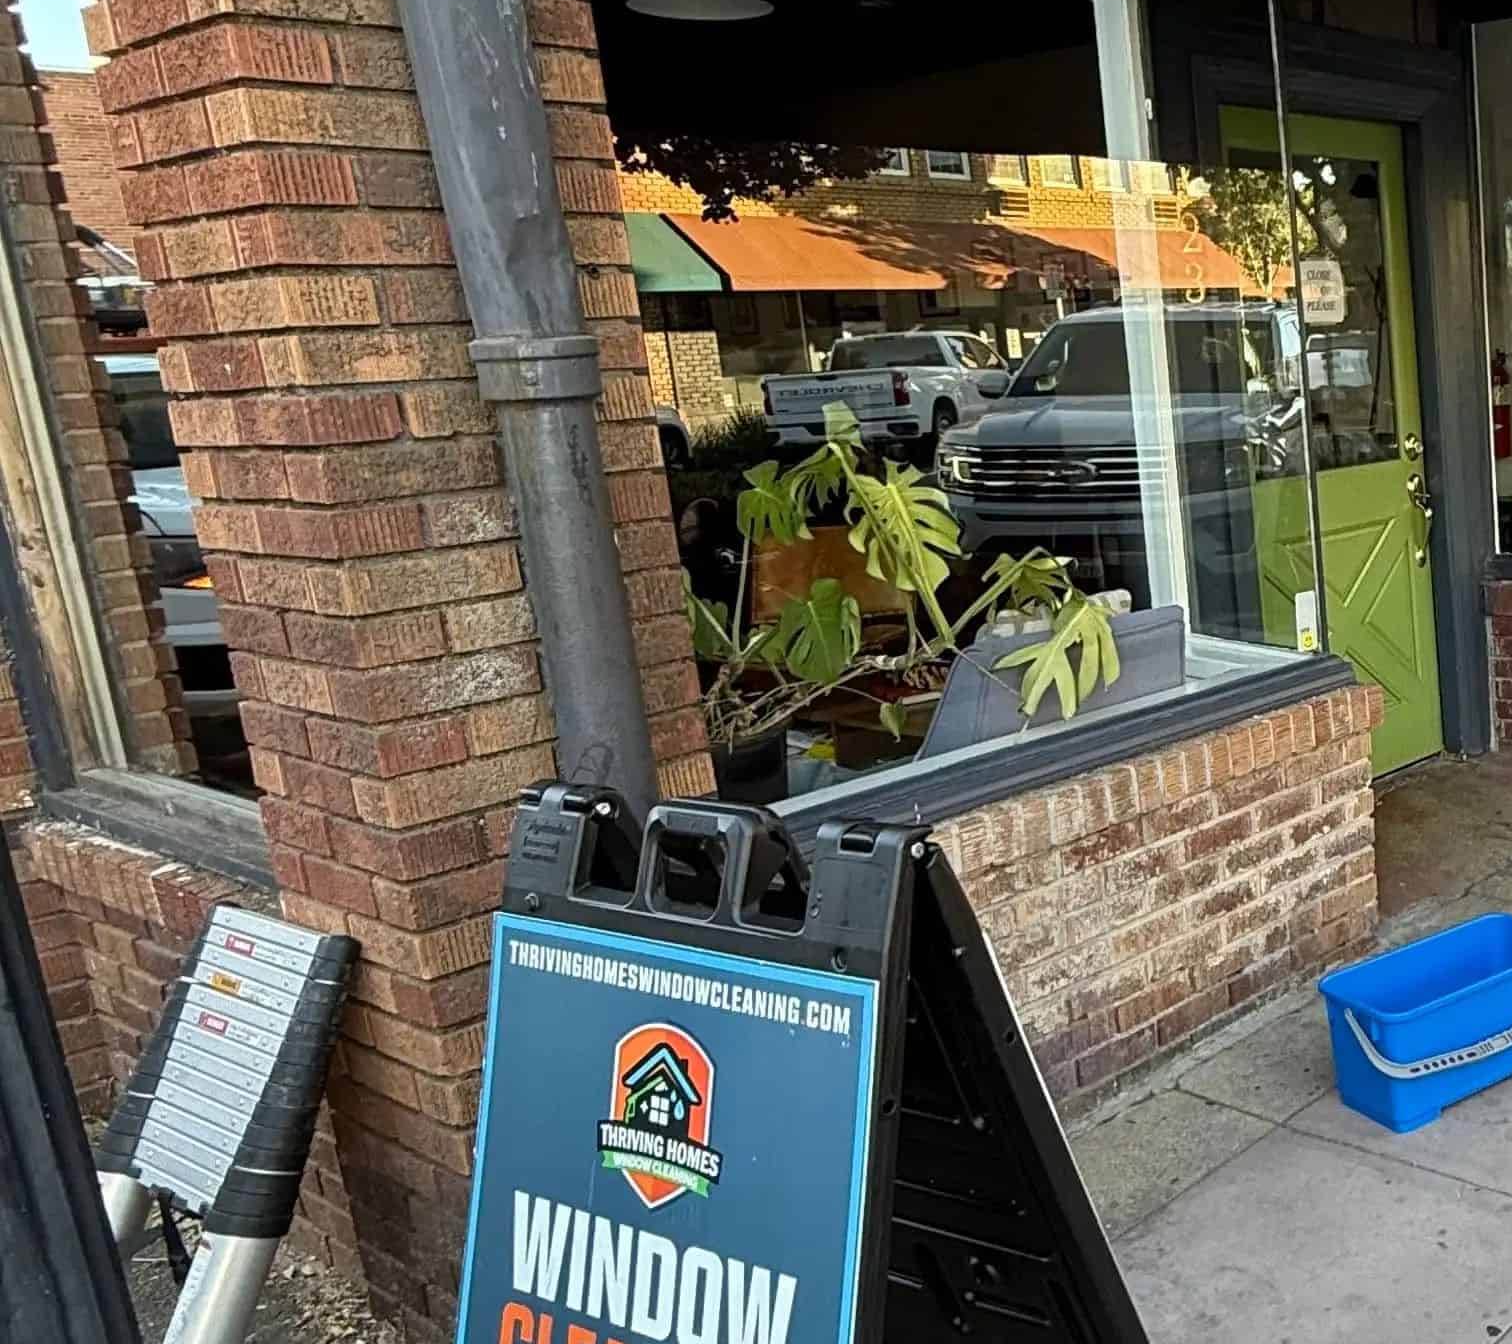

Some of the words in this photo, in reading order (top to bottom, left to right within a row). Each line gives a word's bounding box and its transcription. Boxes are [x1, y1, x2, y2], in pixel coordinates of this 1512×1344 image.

[508, 940, 851, 1036] THRIVINGHOMESWINDOWCLEANING.COM
[600, 1124, 664, 1158] THRIVING
[666, 1139, 720, 1176] HOMES
[613, 1152, 652, 1172] WINDOW
[652, 1161, 699, 1186] CLEANING
